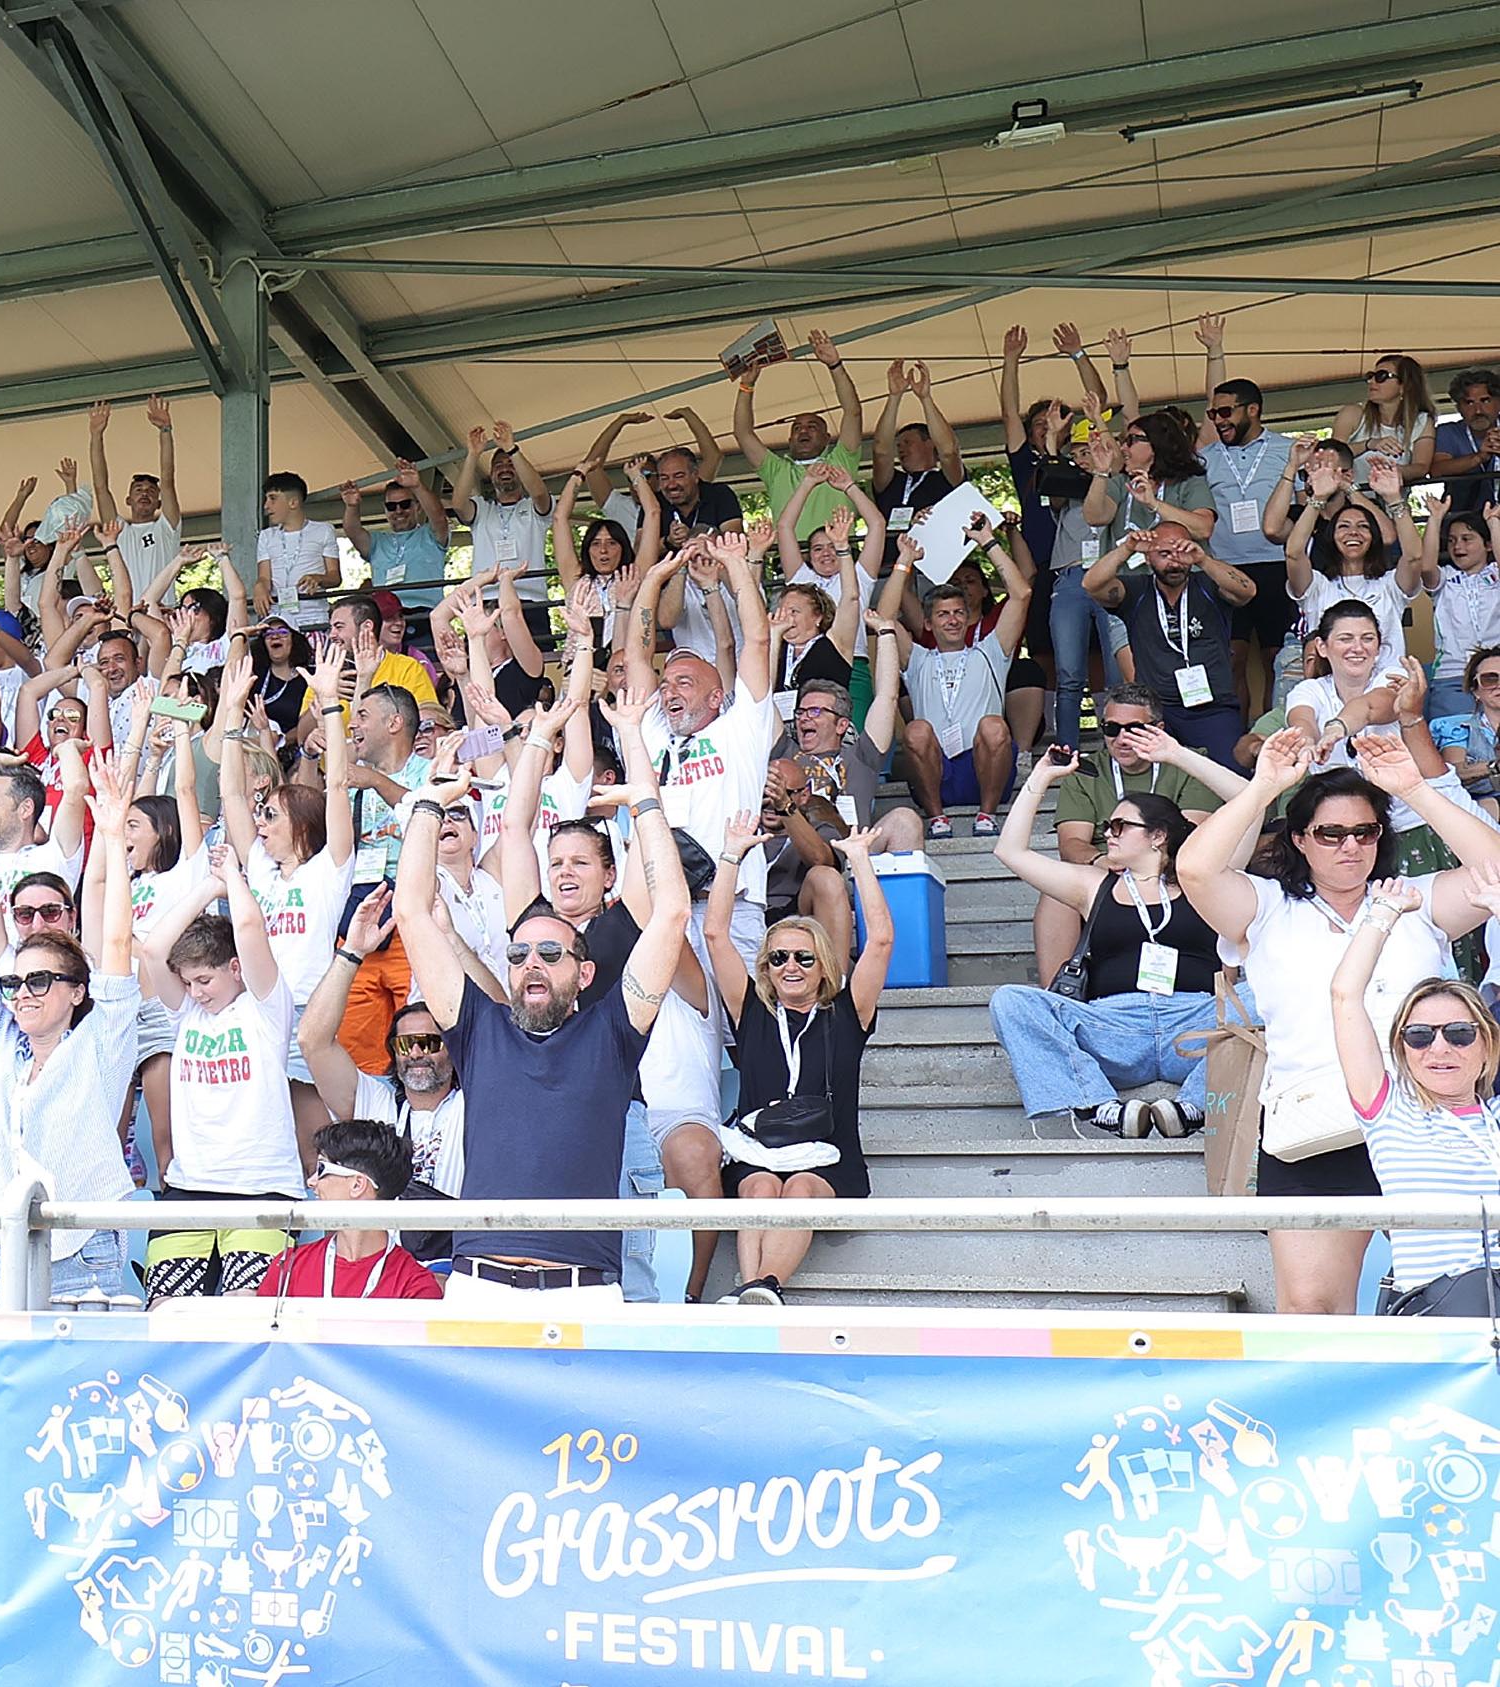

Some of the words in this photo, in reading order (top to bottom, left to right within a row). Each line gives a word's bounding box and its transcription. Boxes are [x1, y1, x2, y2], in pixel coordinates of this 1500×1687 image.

[185, 1027, 247, 1058] ORZA
[196, 1056, 250, 1084] PIETRO
[482, 1446, 943, 1599] Grassroots
